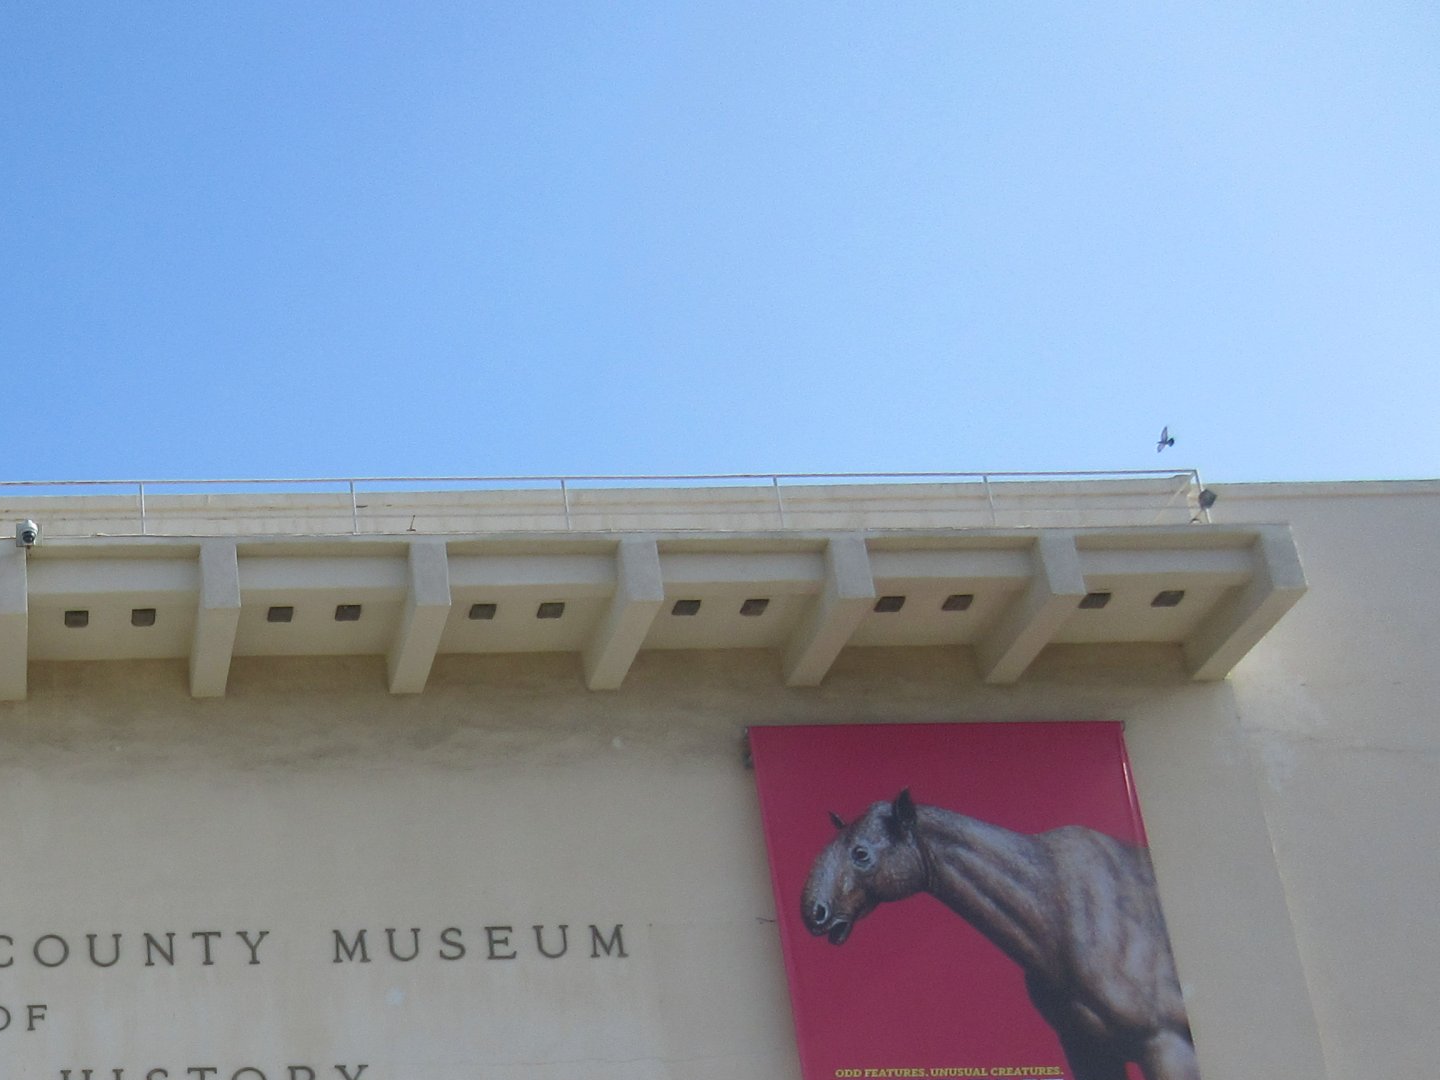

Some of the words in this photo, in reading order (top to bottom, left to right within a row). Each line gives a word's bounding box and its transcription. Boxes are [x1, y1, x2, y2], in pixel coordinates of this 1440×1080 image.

[331, 924, 630, 963] MUSEUM
[835, 1069, 861, 1078] ODD
[864, 1068, 928, 1078] FEATURES.
[930, 1067, 988, 1077] UNUSUAL
[990, 1066, 1064, 1077] CREATURES.
